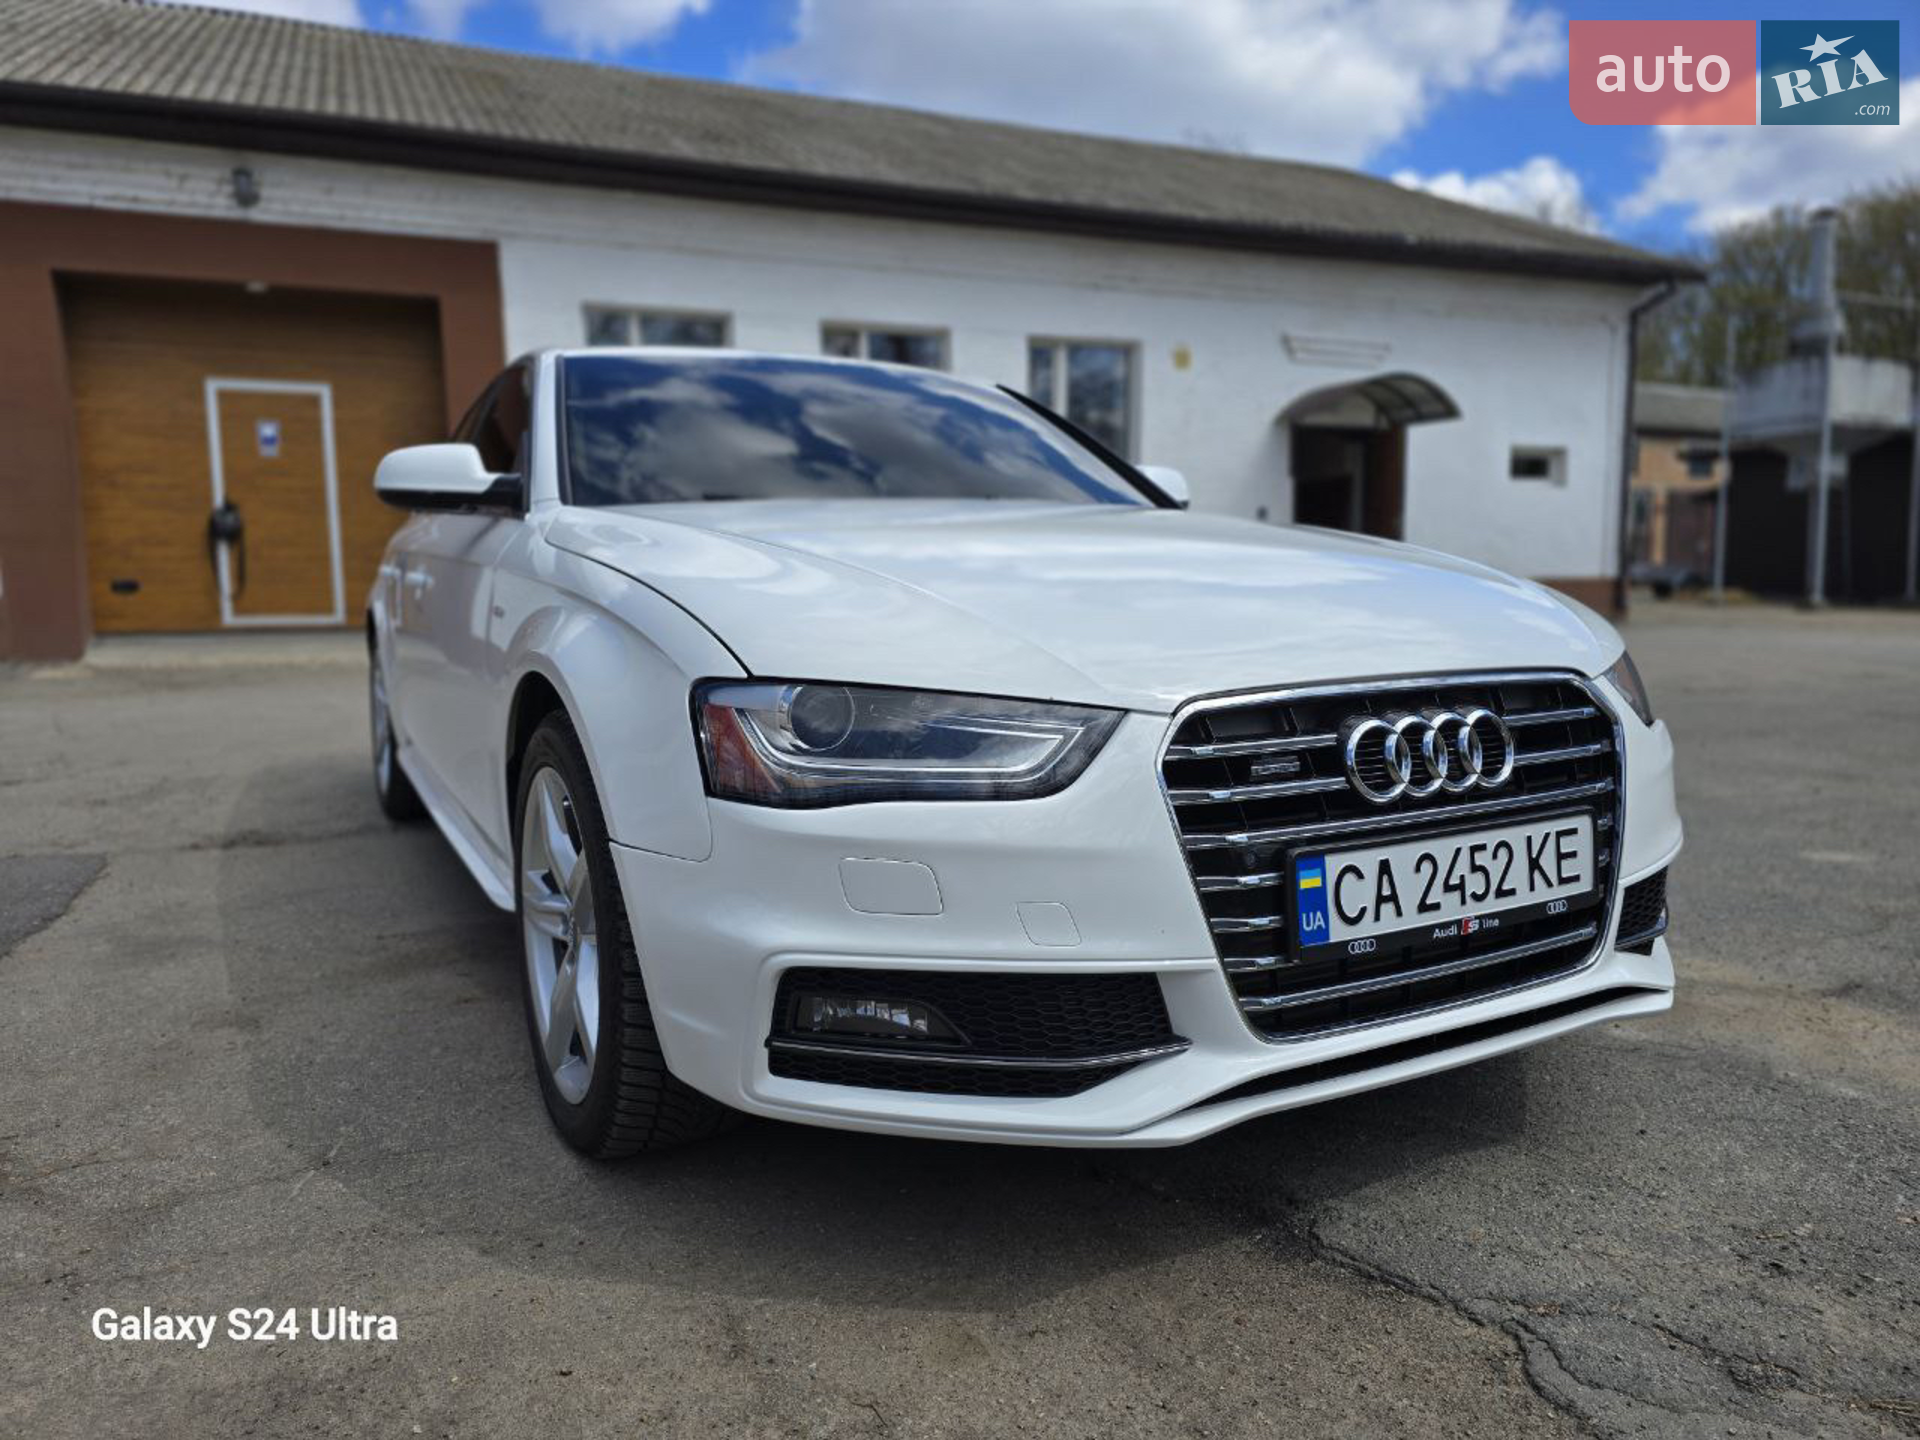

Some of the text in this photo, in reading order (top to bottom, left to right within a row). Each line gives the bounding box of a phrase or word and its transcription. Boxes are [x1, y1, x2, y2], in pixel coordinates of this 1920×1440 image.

[1334, 827, 1581, 926] CA 2452 KE
[1302, 911, 1326, 932] UA
[1433, 924, 1457, 938] Audi
[1482, 917, 1500, 928] line
